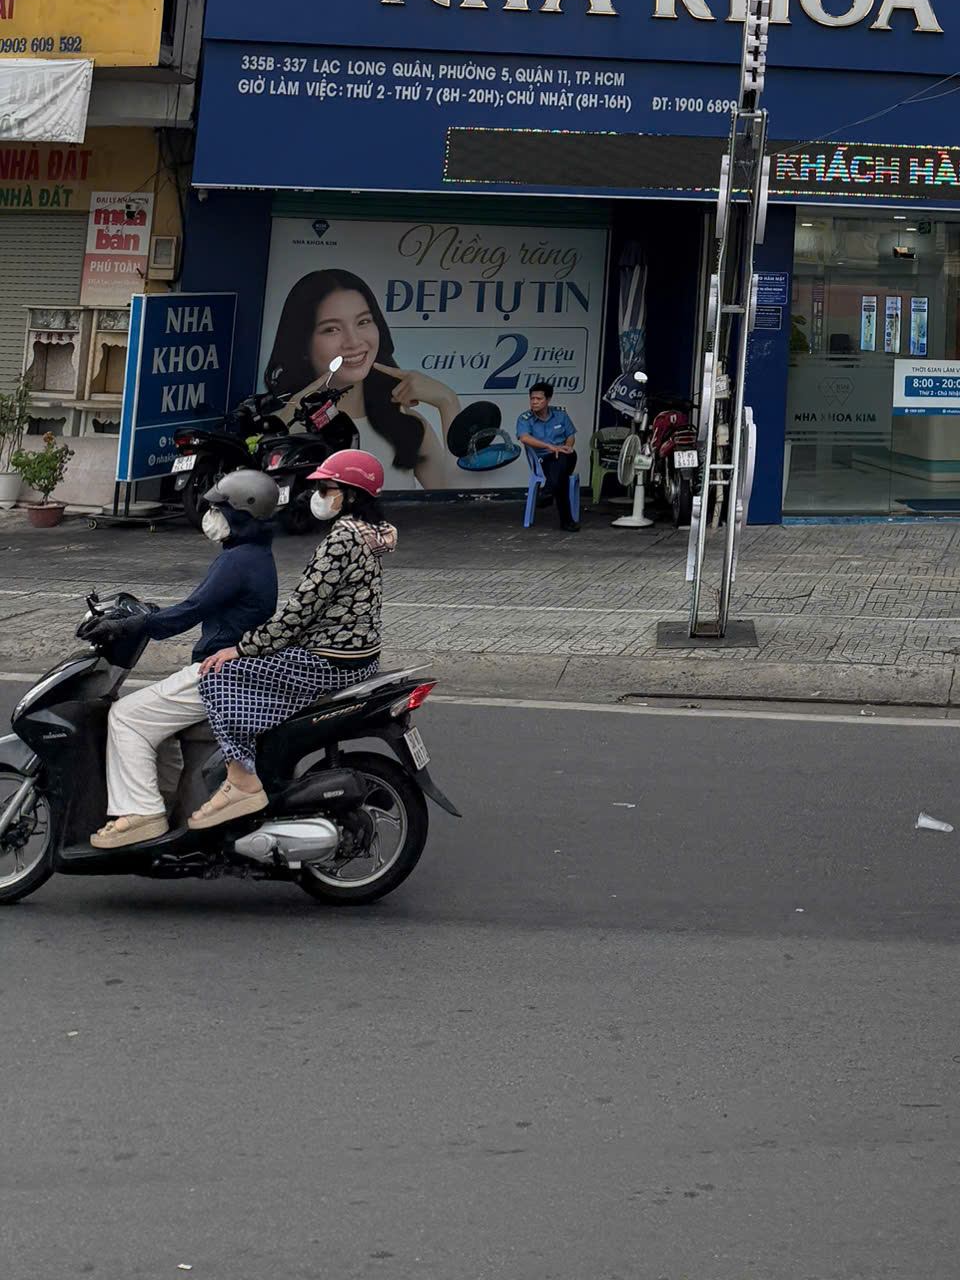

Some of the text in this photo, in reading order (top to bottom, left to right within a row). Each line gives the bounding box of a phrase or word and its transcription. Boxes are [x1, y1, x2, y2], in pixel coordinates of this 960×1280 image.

[31, 36, 54, 53] 609
[59, 35, 82, 52] 592
[313, 59, 341, 77] LẠC
[347, 60, 386, 76] LONG
[392, 60, 435, 80] QUÂN,
[439, 61, 497, 81] PHƯỜNG
[501, 67, 512, 84] 5,
[515, 66, 553, 88] QUẬN
[558, 70, 571, 87] 11,
[575, 71, 591, 86] TP.
[595, 71, 625, 87] HCM
[238, 75, 265, 94] GIỜ
[270, 77, 299, 96] LÀM
[346, 80, 373, 99] THỨ
[425, 87, 433, 101] 7
[506, 86, 535, 105] CHỦ
[540, 89, 574, 110] NHẬT
[576, 95, 632, 113] (8H-16H)
[652, 96, 671, 111] ĐT:
[675, 97, 703, 112] 1900
[707, 99, 738, 114] 6899
[777, 146, 900, 184] KHÁCH
[96, 228, 140, 251] bán
[398, 225, 582, 279] Niềng răng
[90, 260, 111, 273] PHÚ
[385, 279, 590, 321] ĐẸP TỰ TIN
[165, 306, 214, 334] NHA
[152, 344, 219, 374] KHOA
[458, 351, 490, 370] VỚI
[533, 347, 575, 364] Triệu
[483, 333, 528, 390] 2
[524, 373, 580, 391] Tháng
[913, 378, 935, 388] 8:00
[161, 383, 205, 413] KIM
[794, 413, 817, 422] NHA
[855, 413, 877, 422] KIM
